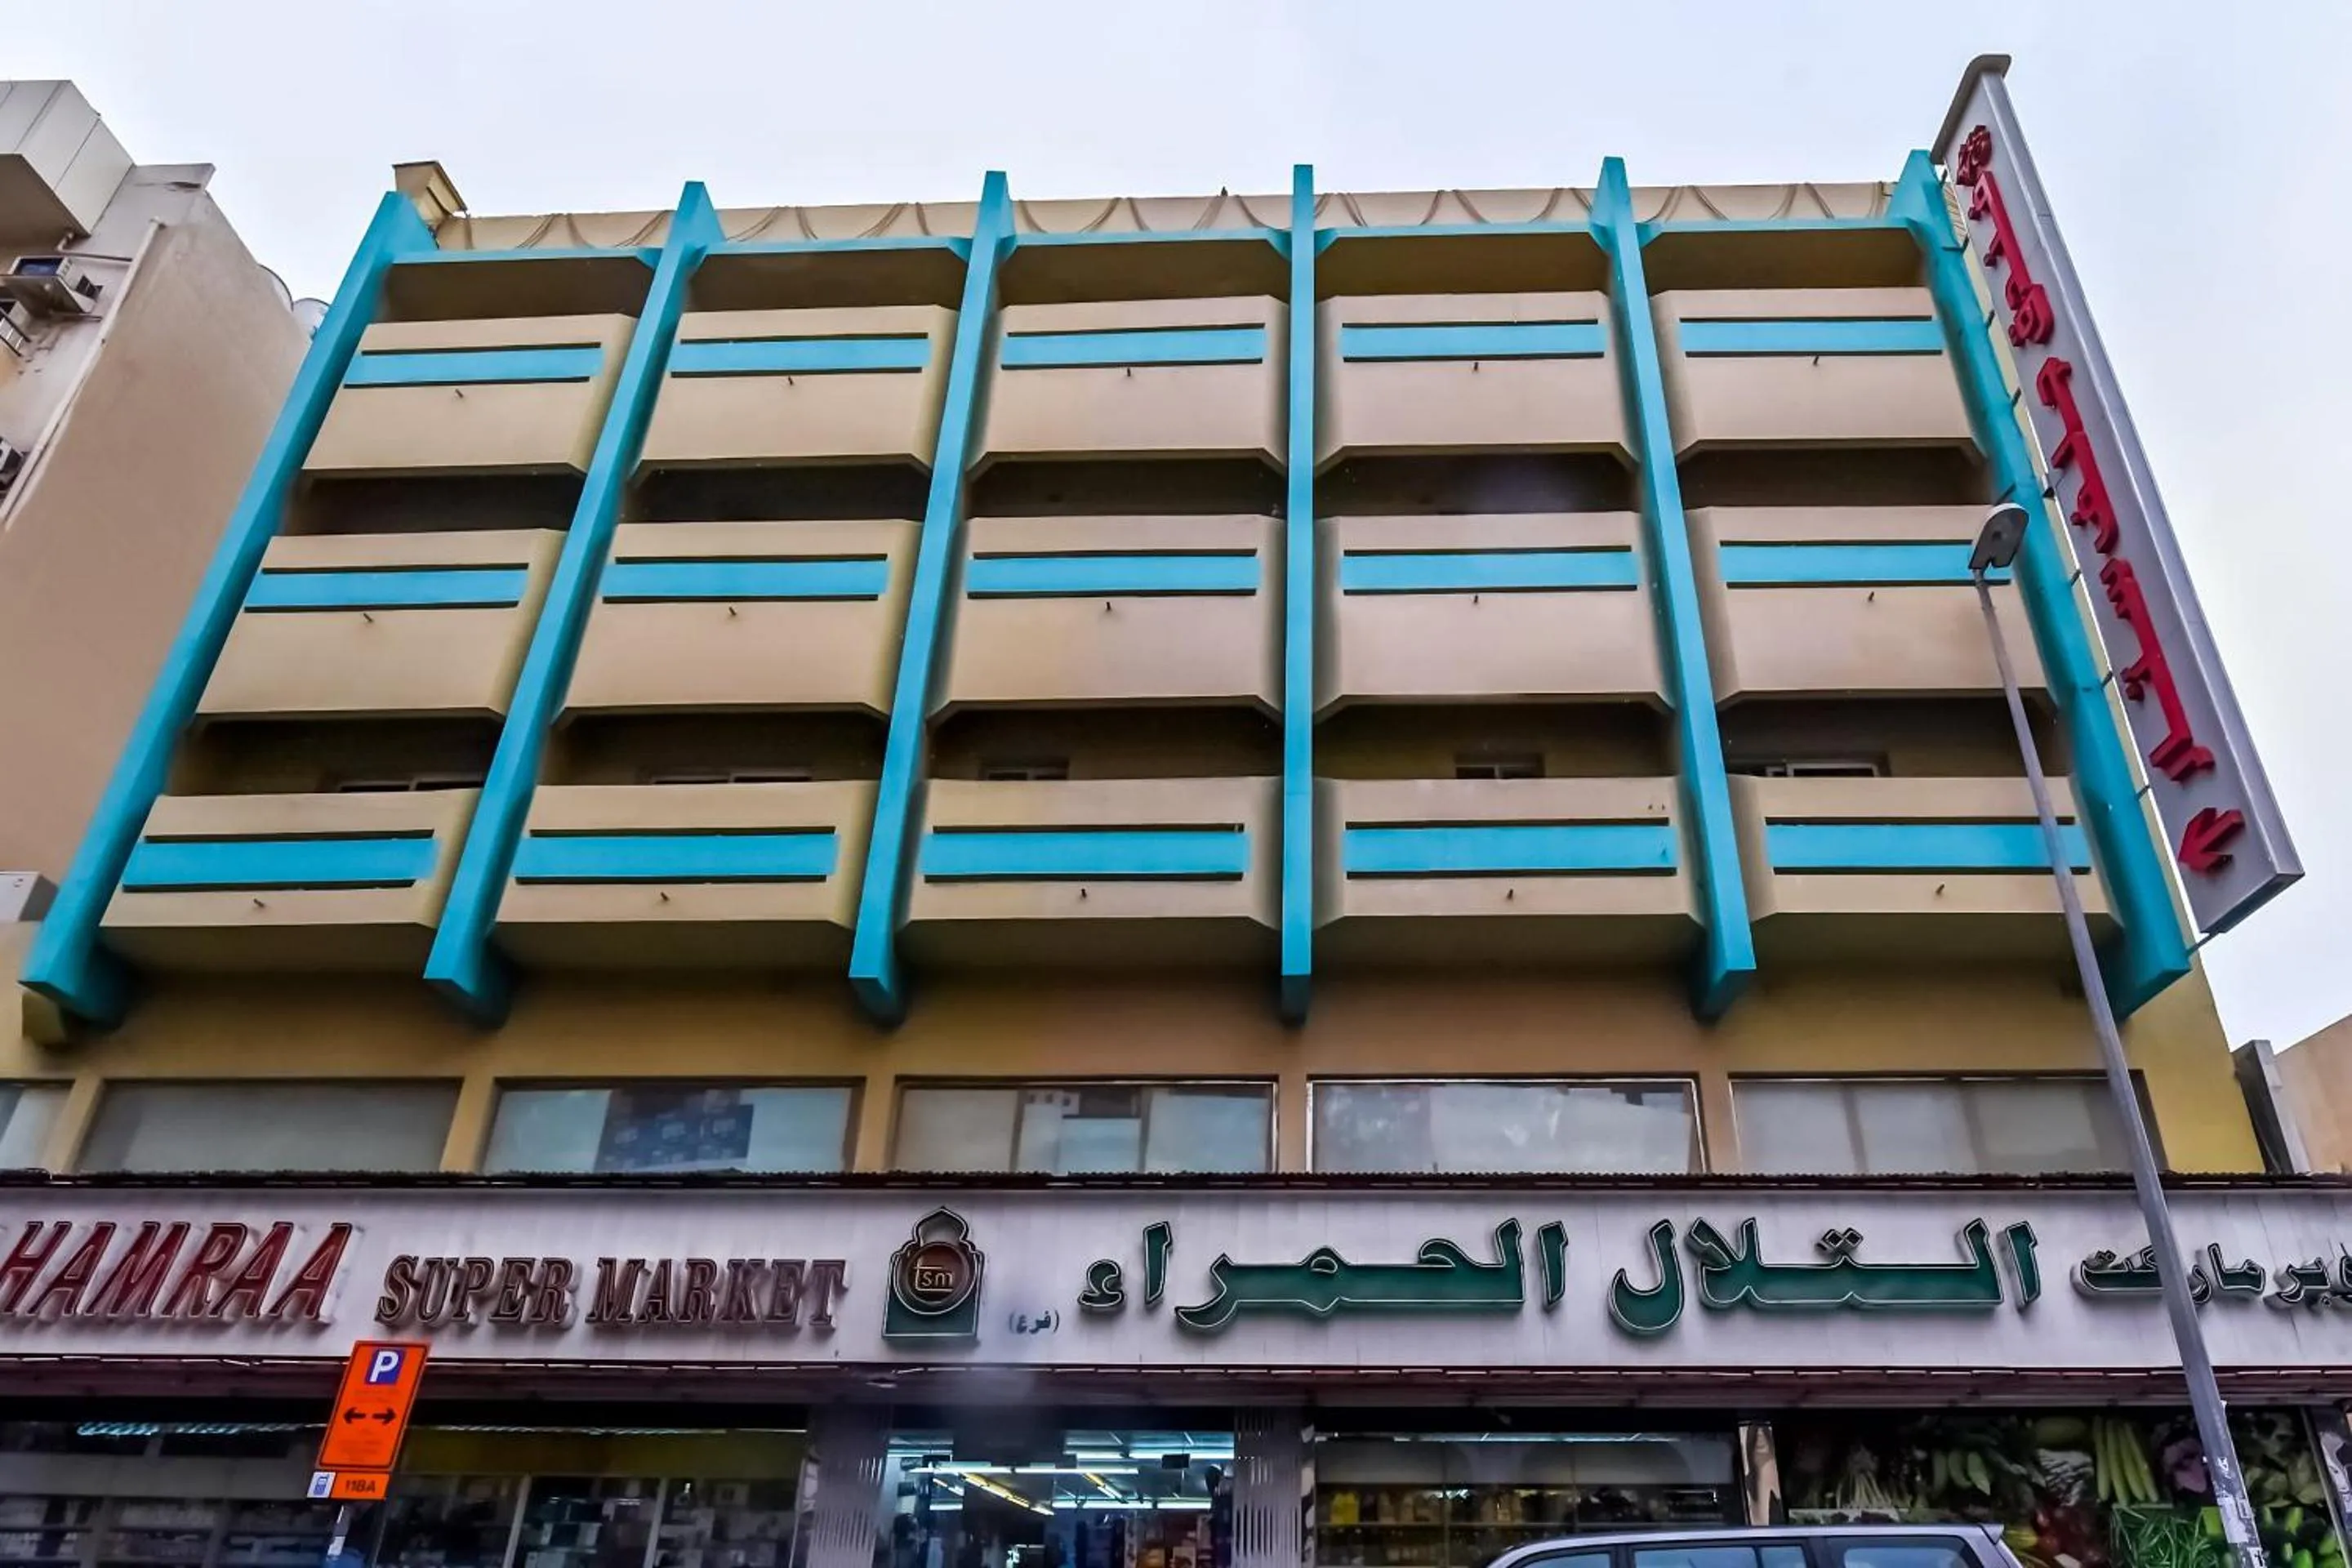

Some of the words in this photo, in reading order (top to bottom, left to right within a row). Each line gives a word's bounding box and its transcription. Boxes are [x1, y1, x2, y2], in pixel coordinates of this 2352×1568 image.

[1967, 171, 2055, 347] فندق
[2100, 558, 2216, 782] ستار
[0, 1221, 353, 1318] HAMRAA
[375, 1255, 575, 1324] SUPER
[586, 1257, 847, 1326] MARKET
[1077, 1218, 1568, 1330] الحمراء
[1609, 1217, 2040, 1334] التلال
[370, 1351, 399, 1383] P
